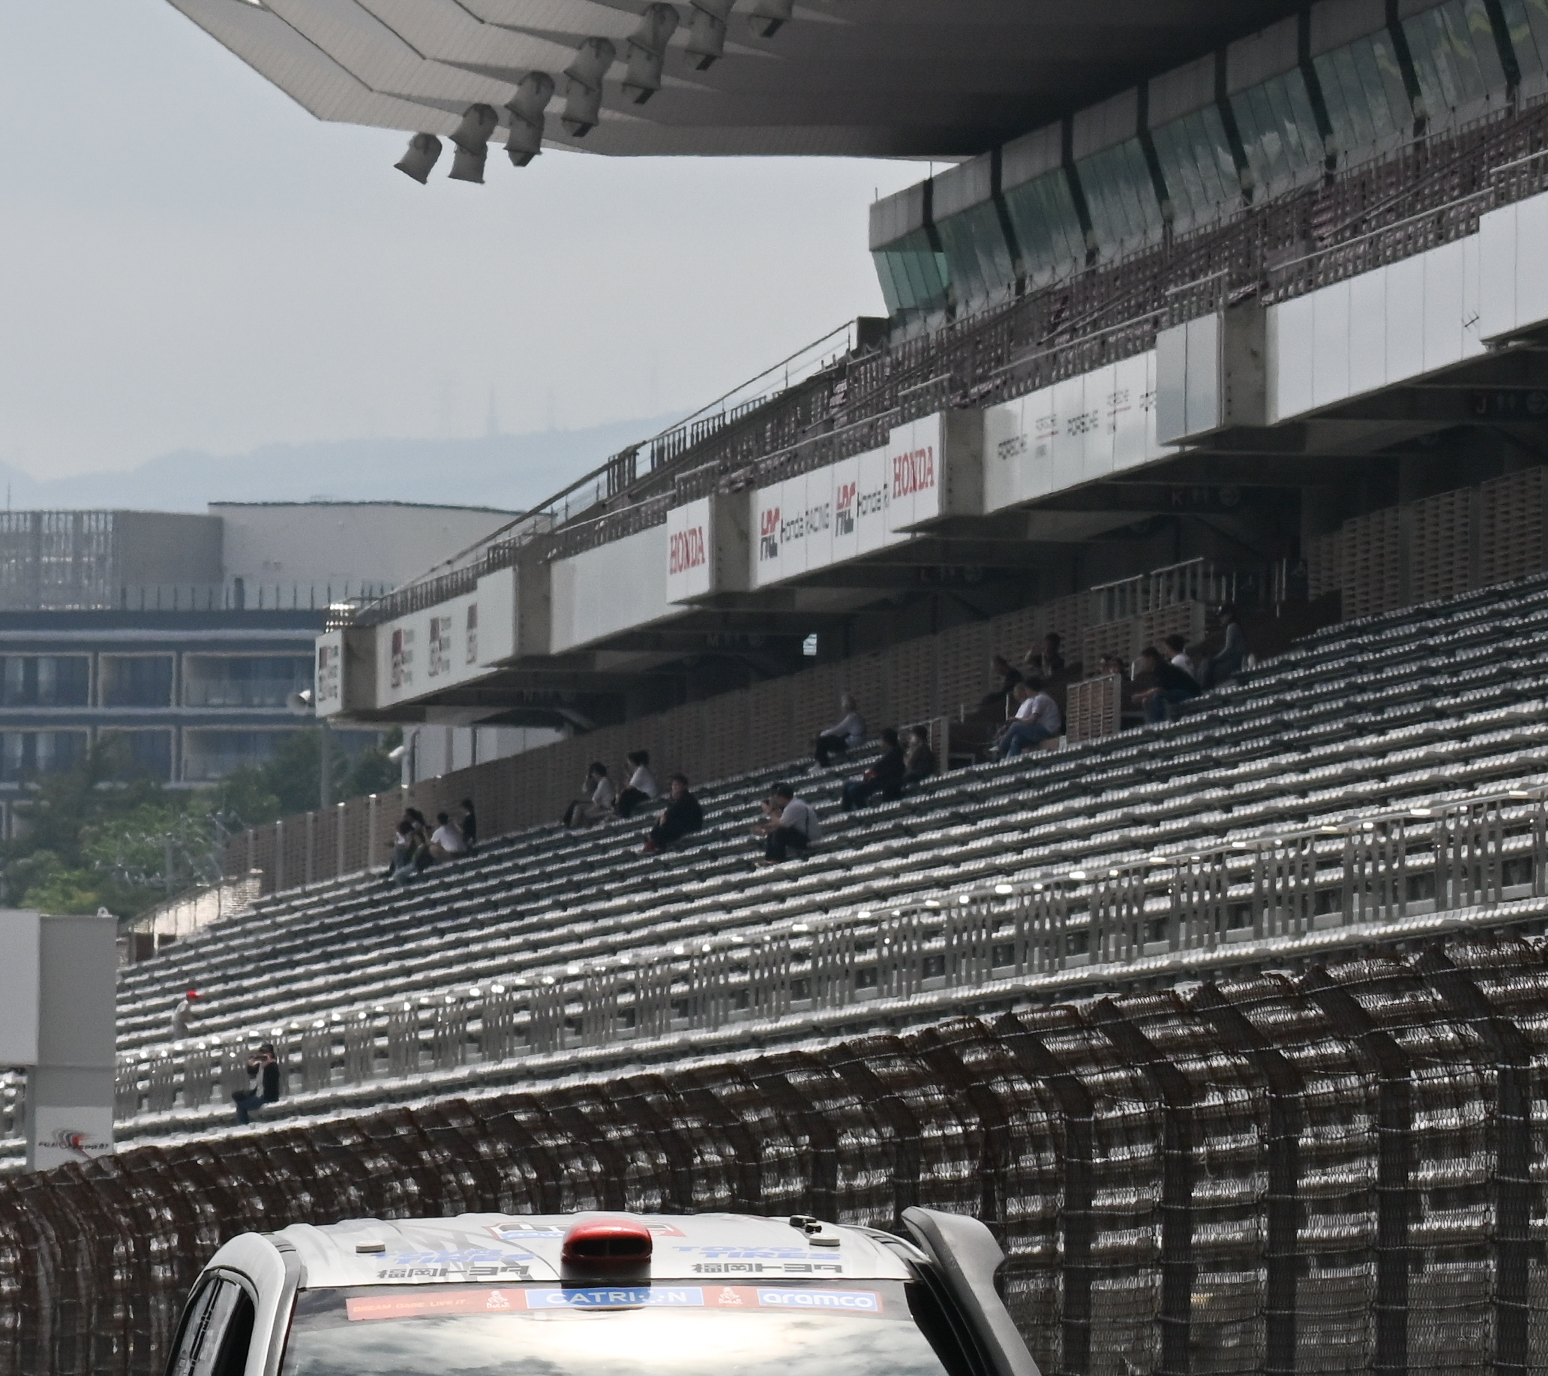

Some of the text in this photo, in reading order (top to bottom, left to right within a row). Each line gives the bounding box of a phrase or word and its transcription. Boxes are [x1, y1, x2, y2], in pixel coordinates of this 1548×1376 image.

[893, 446, 934, 499] HONDA
[670, 526, 705, 575] HONDA
[763, 1292, 874, 1308] aramco
